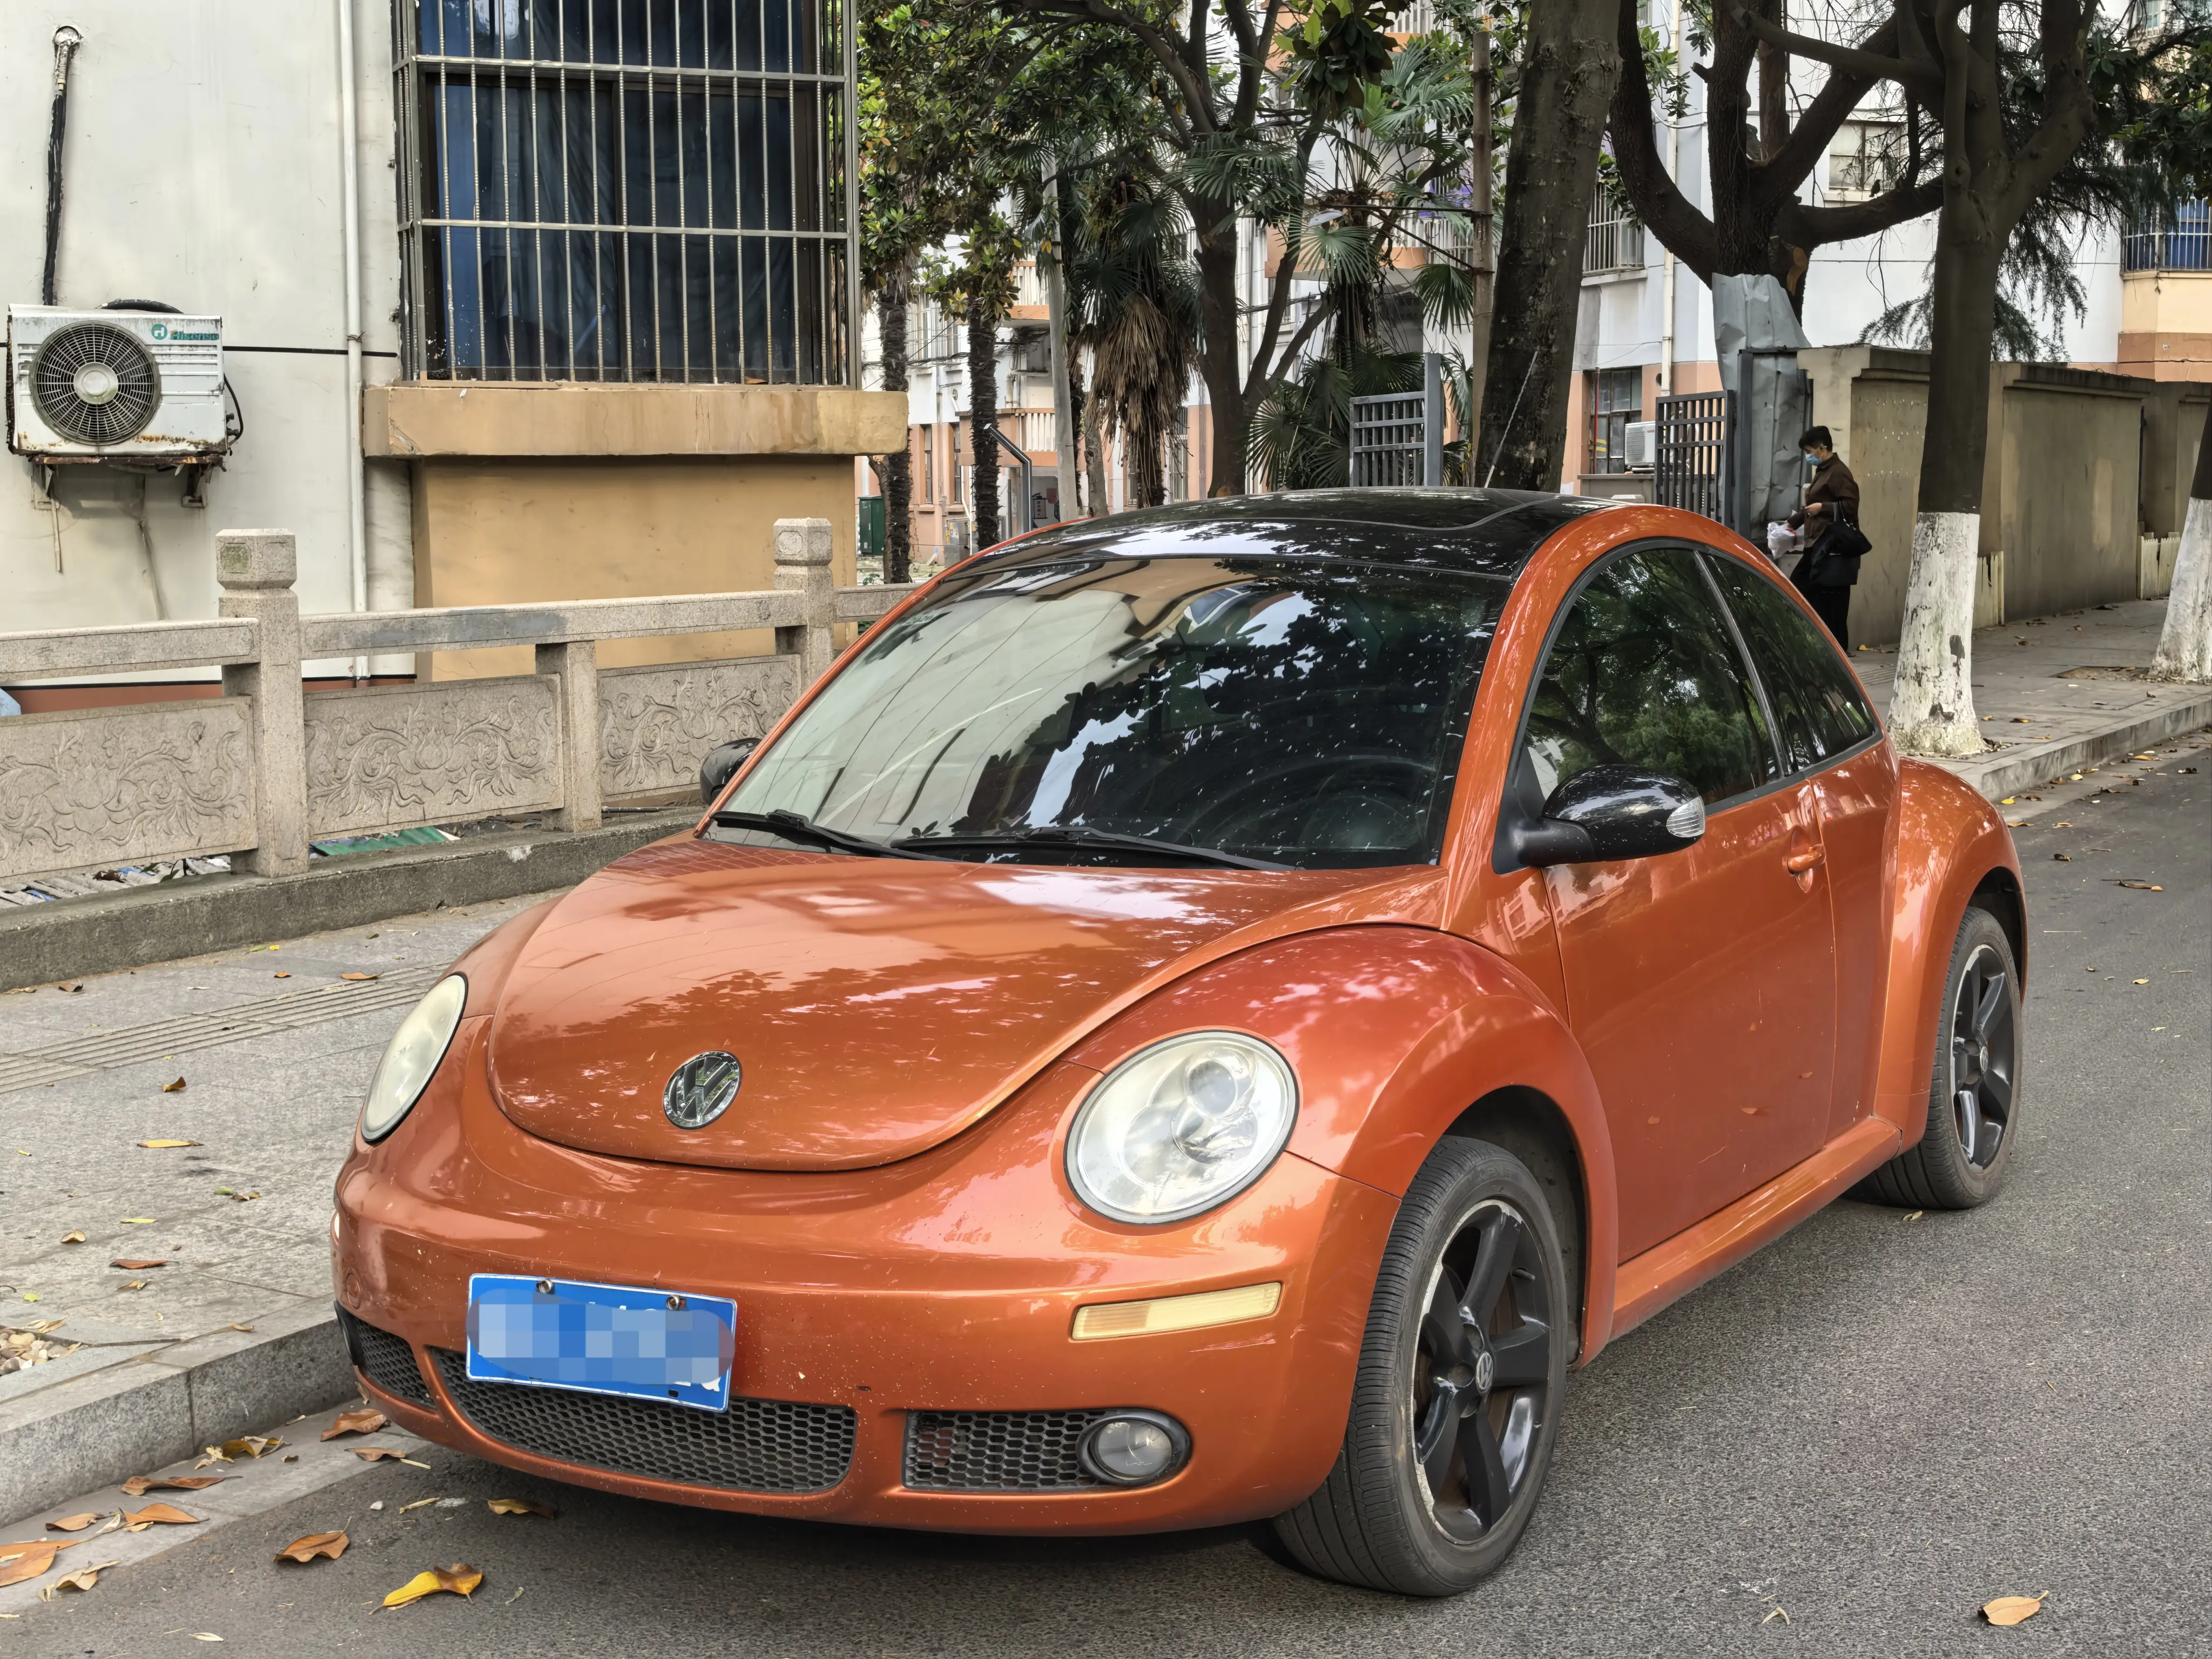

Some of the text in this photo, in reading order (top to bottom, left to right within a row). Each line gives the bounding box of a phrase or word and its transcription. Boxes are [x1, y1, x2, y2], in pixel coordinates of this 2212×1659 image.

[170, 329, 220, 340] Hisense
[665, 1053, 739, 1127] VW
[1476, 1352, 1493, 1390] VW
